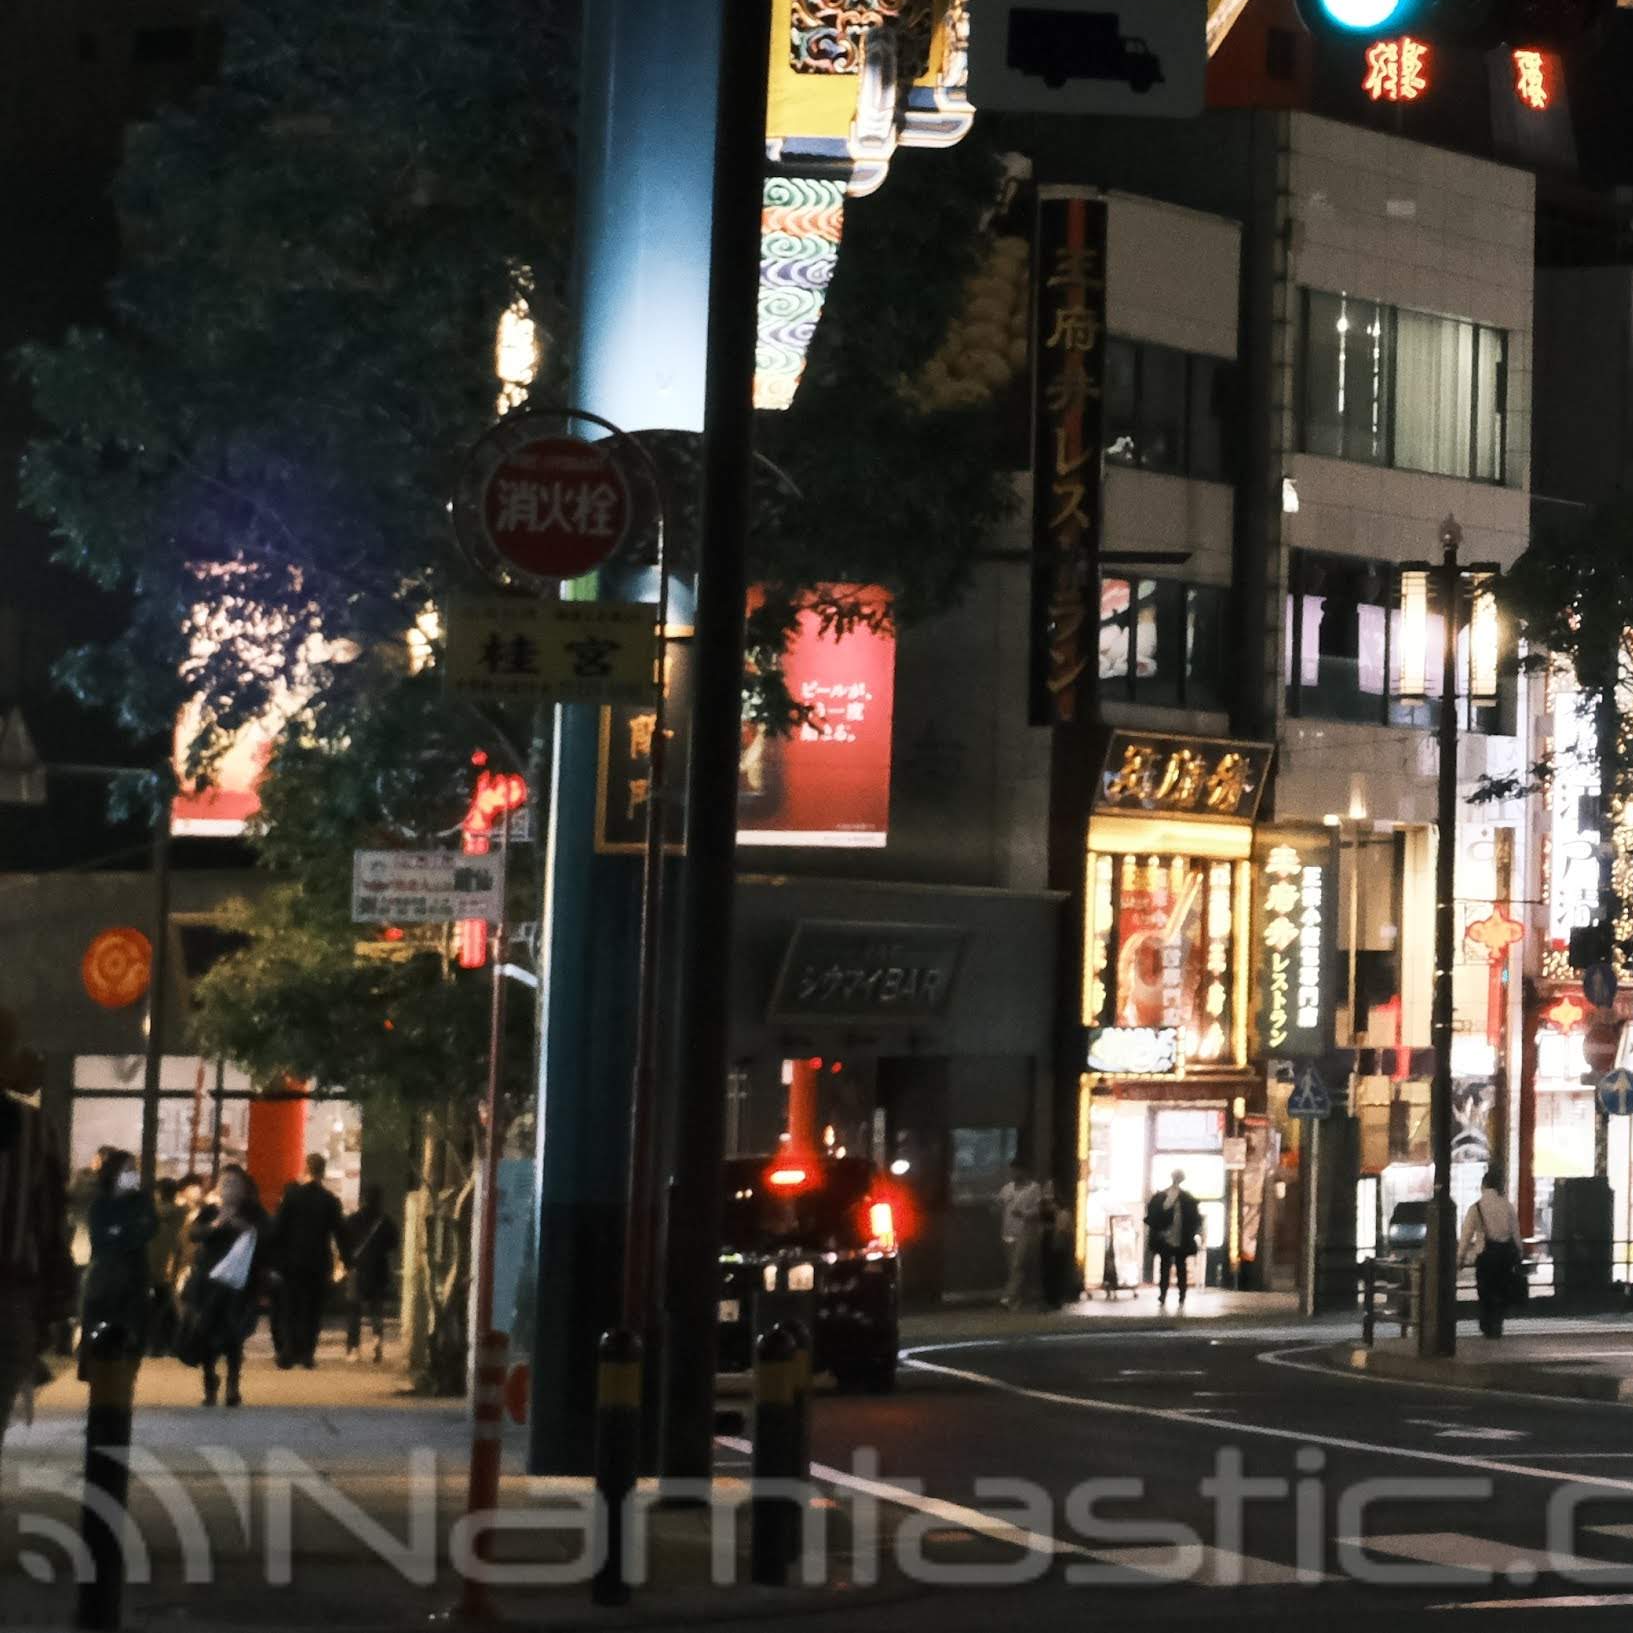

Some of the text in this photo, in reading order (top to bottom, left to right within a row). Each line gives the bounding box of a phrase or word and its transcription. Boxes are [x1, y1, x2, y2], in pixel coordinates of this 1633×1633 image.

[1045, 245, 1103, 697] 王府井レスラン
[495, 479, 619, 535] 消火栓
[804, 701, 865, 721] う一度
